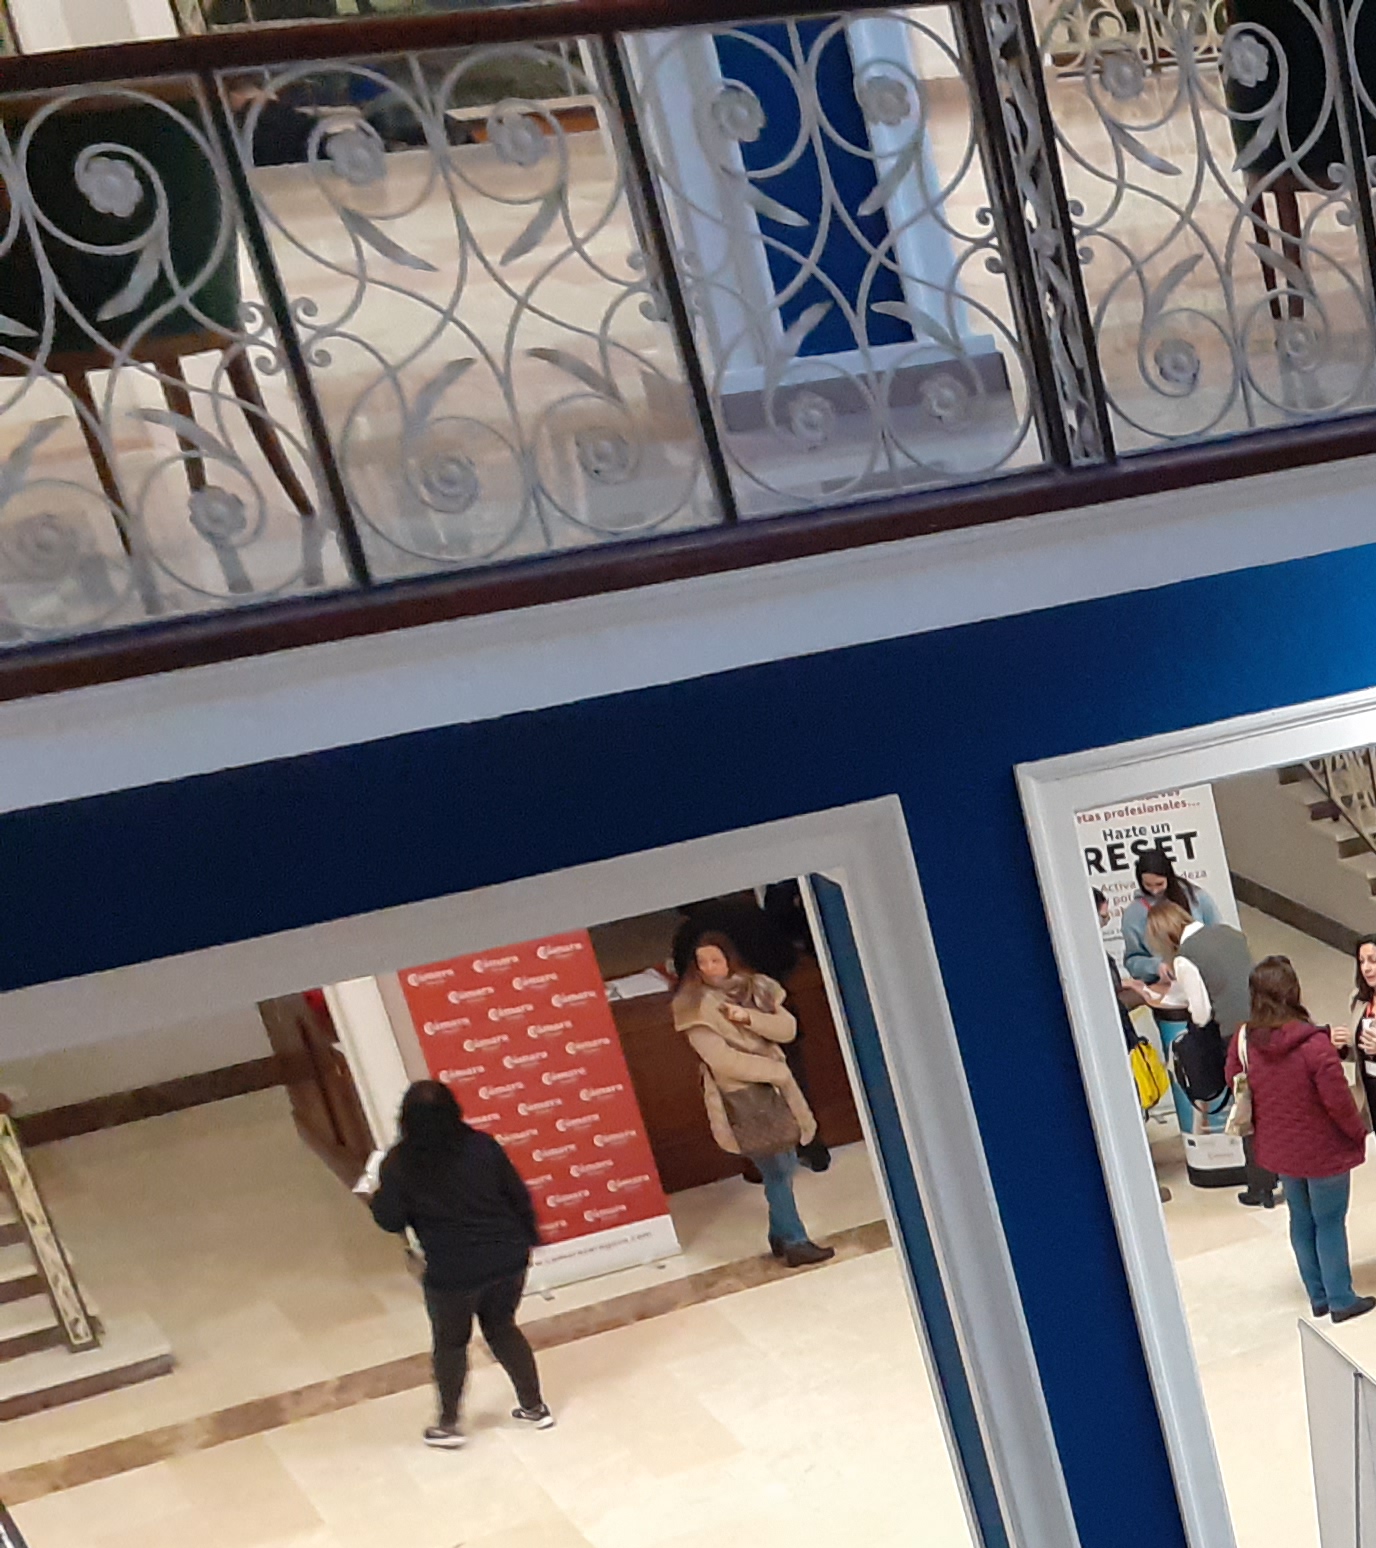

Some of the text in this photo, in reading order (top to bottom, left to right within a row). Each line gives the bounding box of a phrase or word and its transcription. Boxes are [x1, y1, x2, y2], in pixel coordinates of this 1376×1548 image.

[1102, 822, 1171, 842] Hazte un
[1084, 830, 1198, 876] RESET
